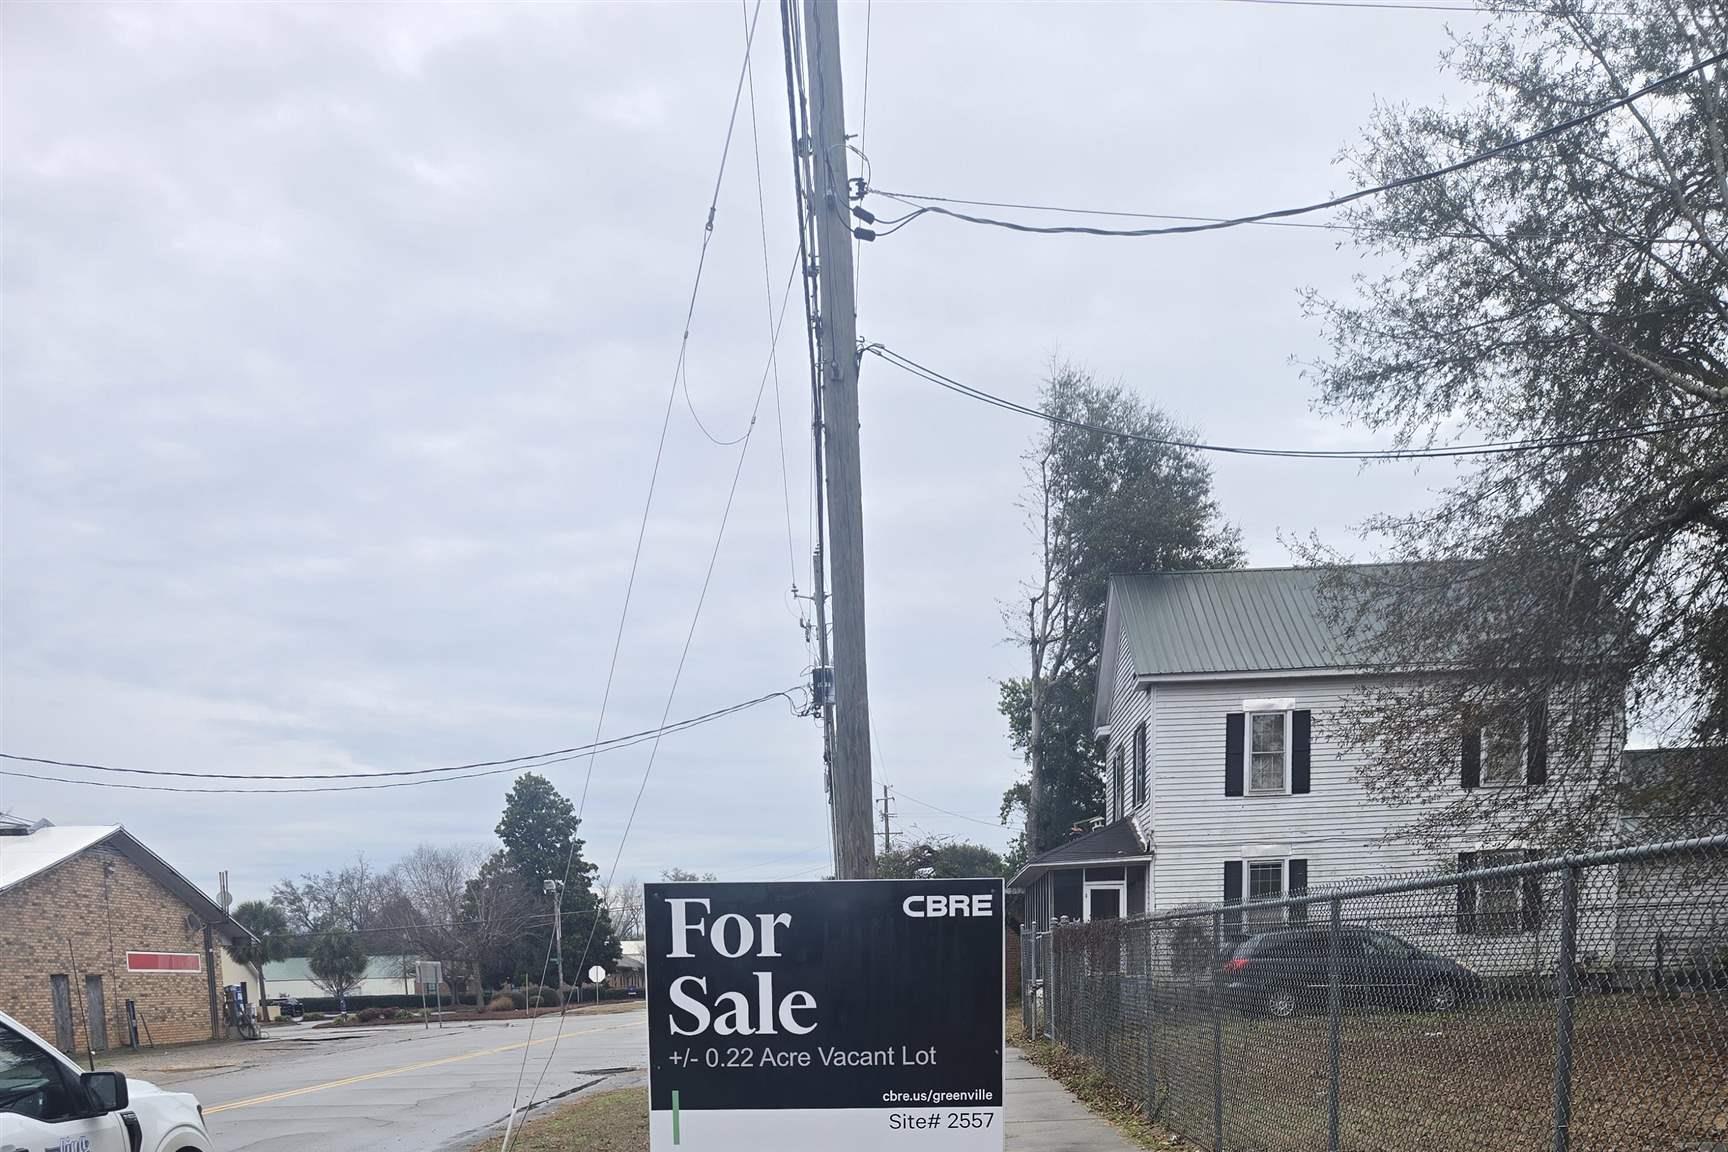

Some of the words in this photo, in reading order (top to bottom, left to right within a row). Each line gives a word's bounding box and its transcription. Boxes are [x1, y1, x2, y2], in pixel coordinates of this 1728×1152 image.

[902, 894, 993, 918] CBRE
[664, 898, 792, 958] For
[668, 971, 818, 1036] Sale
[668, 1047, 699, 1067] +/-
[705, 1047, 754, 1068] 0.22
[759, 1047, 811, 1067] Acre
[817, 1046, 895, 1066] Vacant
[902, 1045, 937, 1066] Lot
[882, 1088, 993, 1104] cbre.us/greenville
[889, 1113, 942, 1130] Site#
[947, 1112, 994, 1129] 2557
